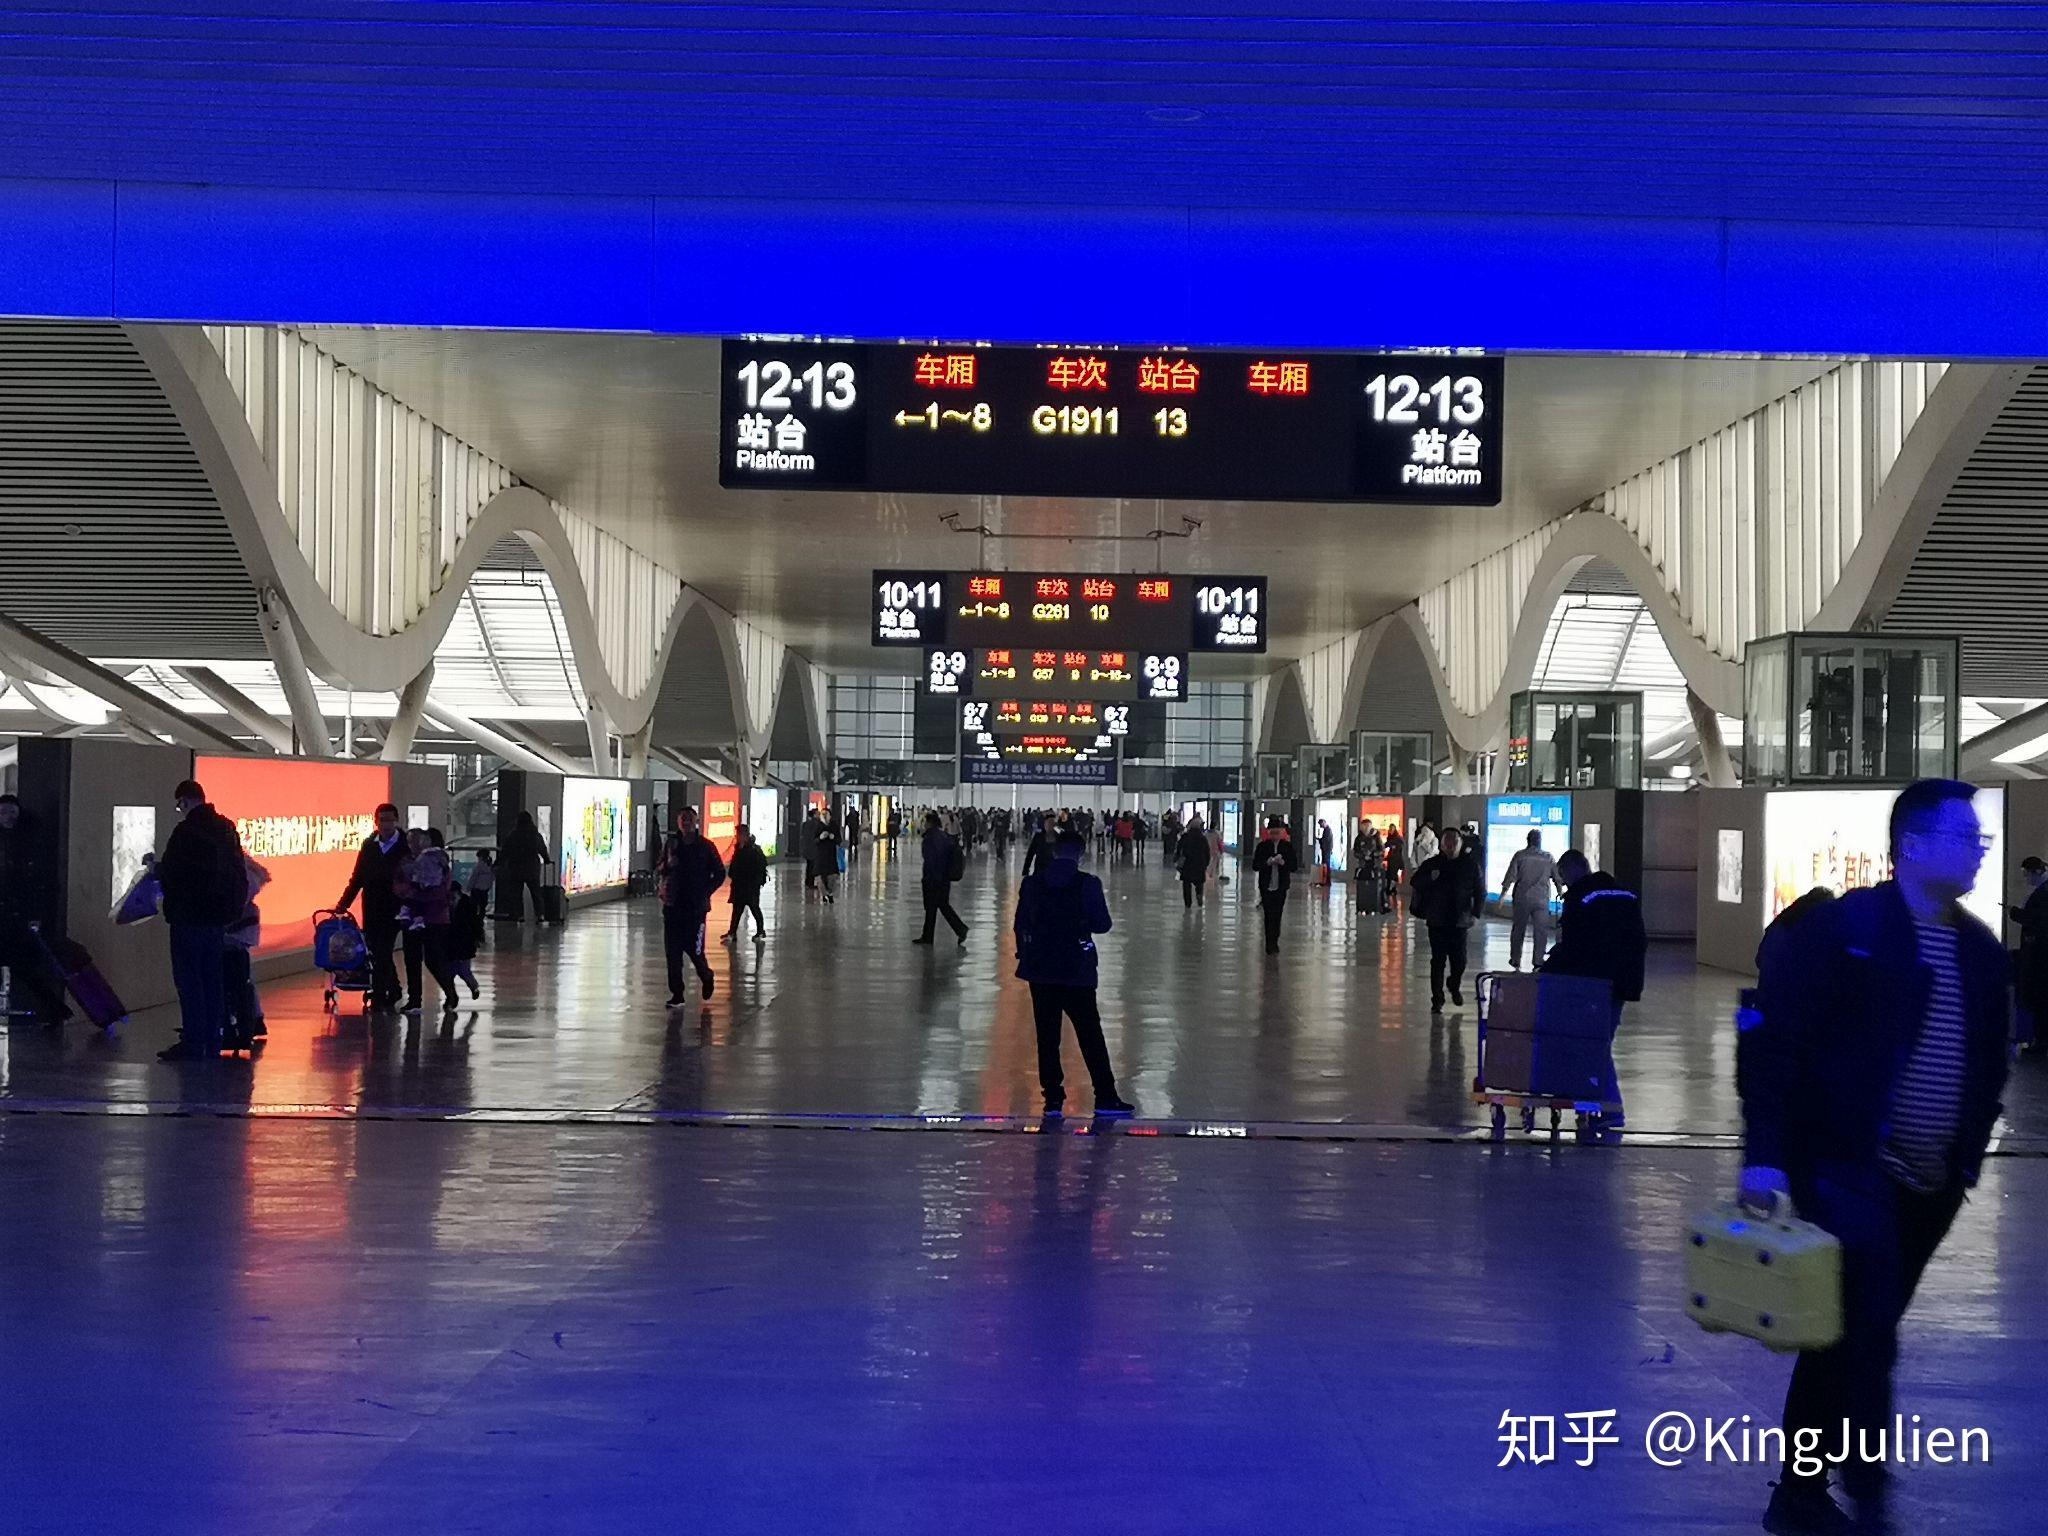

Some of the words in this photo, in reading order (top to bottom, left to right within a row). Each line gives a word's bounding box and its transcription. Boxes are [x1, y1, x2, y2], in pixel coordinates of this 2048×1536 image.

[915, 352, 976, 385] 车厢
[1048, 356, 1107, 388] 车次
[1139, 356, 1200, 390] 站台
[1249, 361, 1308, 392] 车厢
[737, 412, 807, 450] 站台
[1032, 405, 1119, 435] G1911
[1154, 407, 1189, 436] 13
[1411, 428, 1482, 465] 站台
[736, 450, 815, 470] Platform
[1403, 464, 1482, 484] Platform
[970, 577, 1001, 596] 车厢
[1037, 579, 1068, 597] 车次
[1083, 579, 1115, 598] 站台
[1139, 581, 1169, 598] 车厢
[879, 607, 916, 628] 站台
[1032, 603, 1070, 620] G261
[1090, 604, 1109, 621] 10
[1219, 613, 1257, 635] 站台
